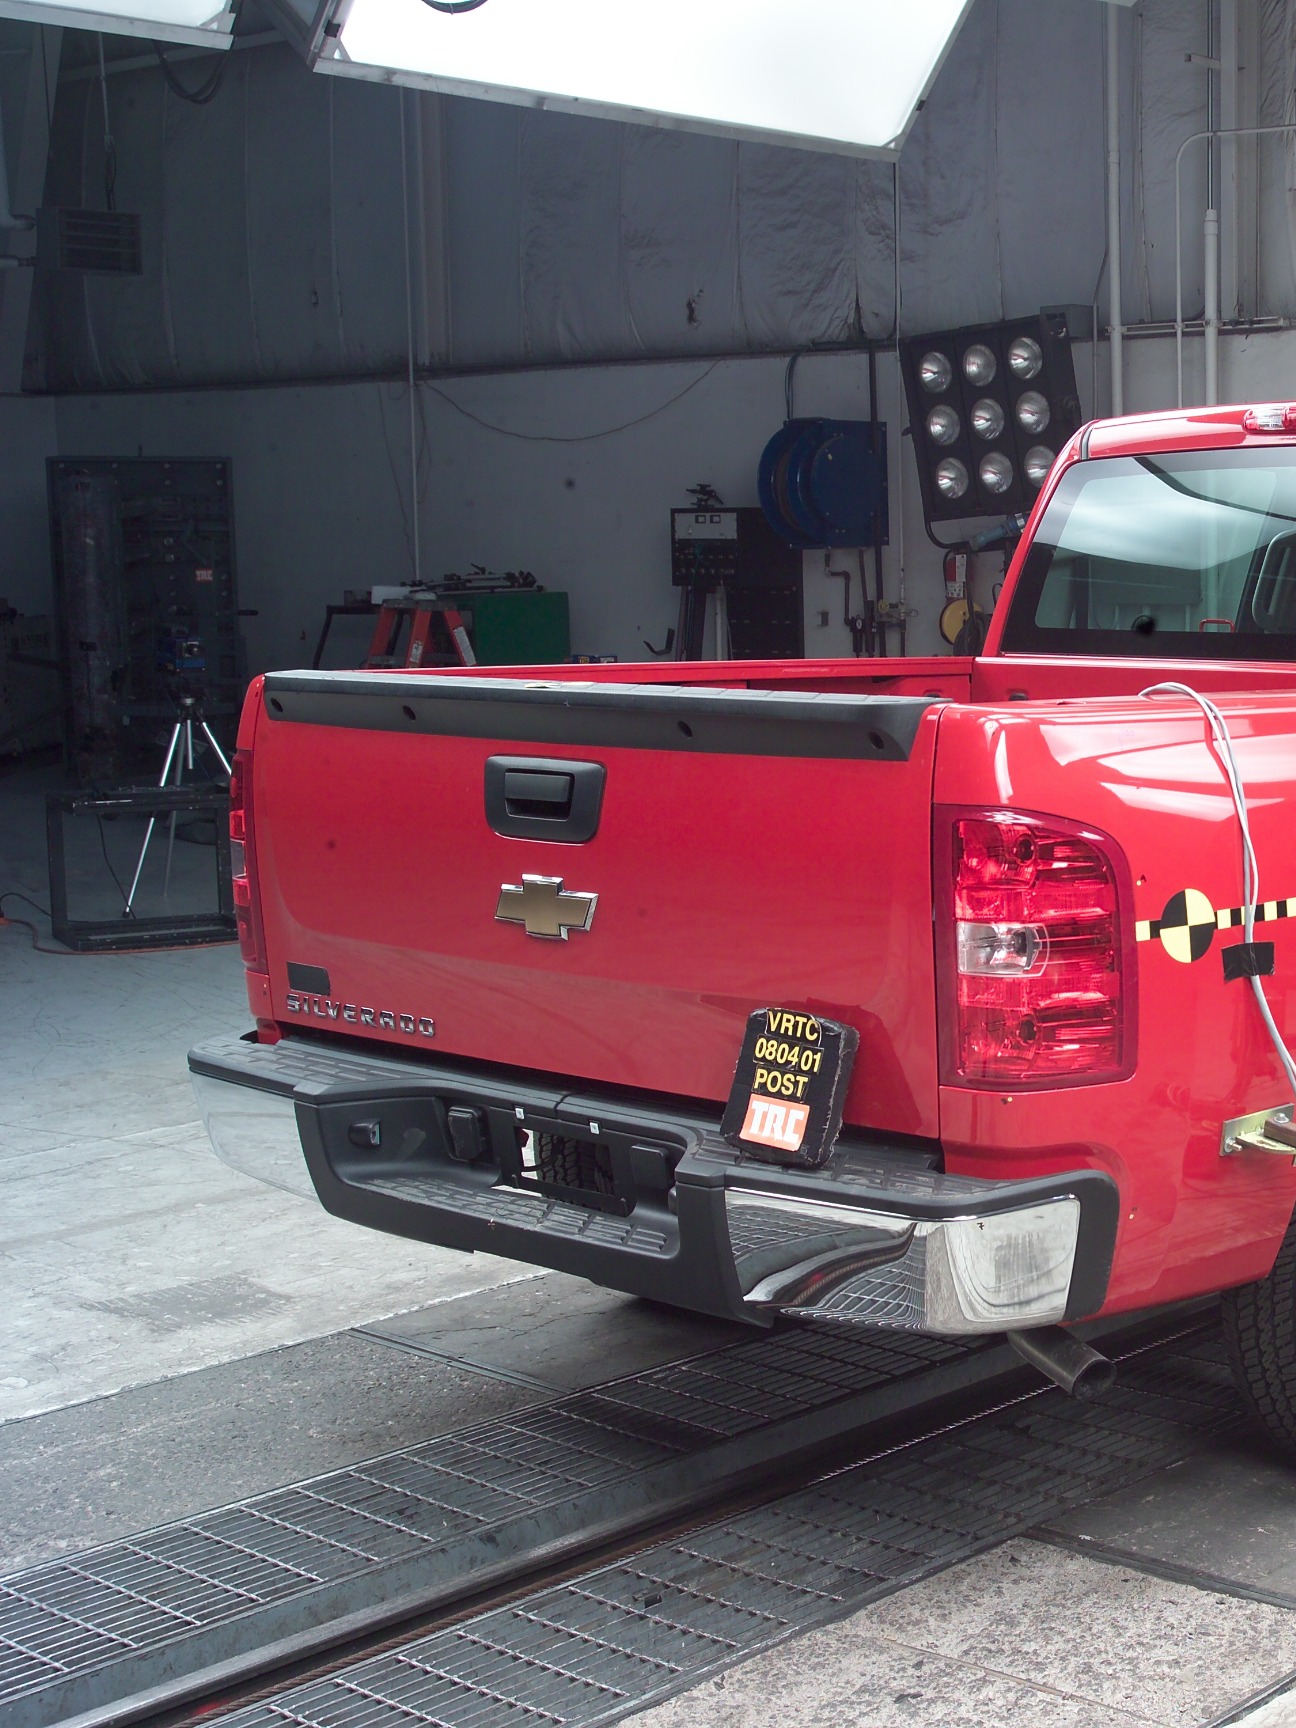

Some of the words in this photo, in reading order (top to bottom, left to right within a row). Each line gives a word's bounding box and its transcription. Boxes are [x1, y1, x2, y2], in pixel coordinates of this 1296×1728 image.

[286, 993, 436, 1038] SILVERADO
[768, 1012, 819, 1040] VRTC
[755, 1038, 821, 1073] 080401
[753, 1069, 808, 1097] POST
[750, 1101, 804, 1142] TRC
